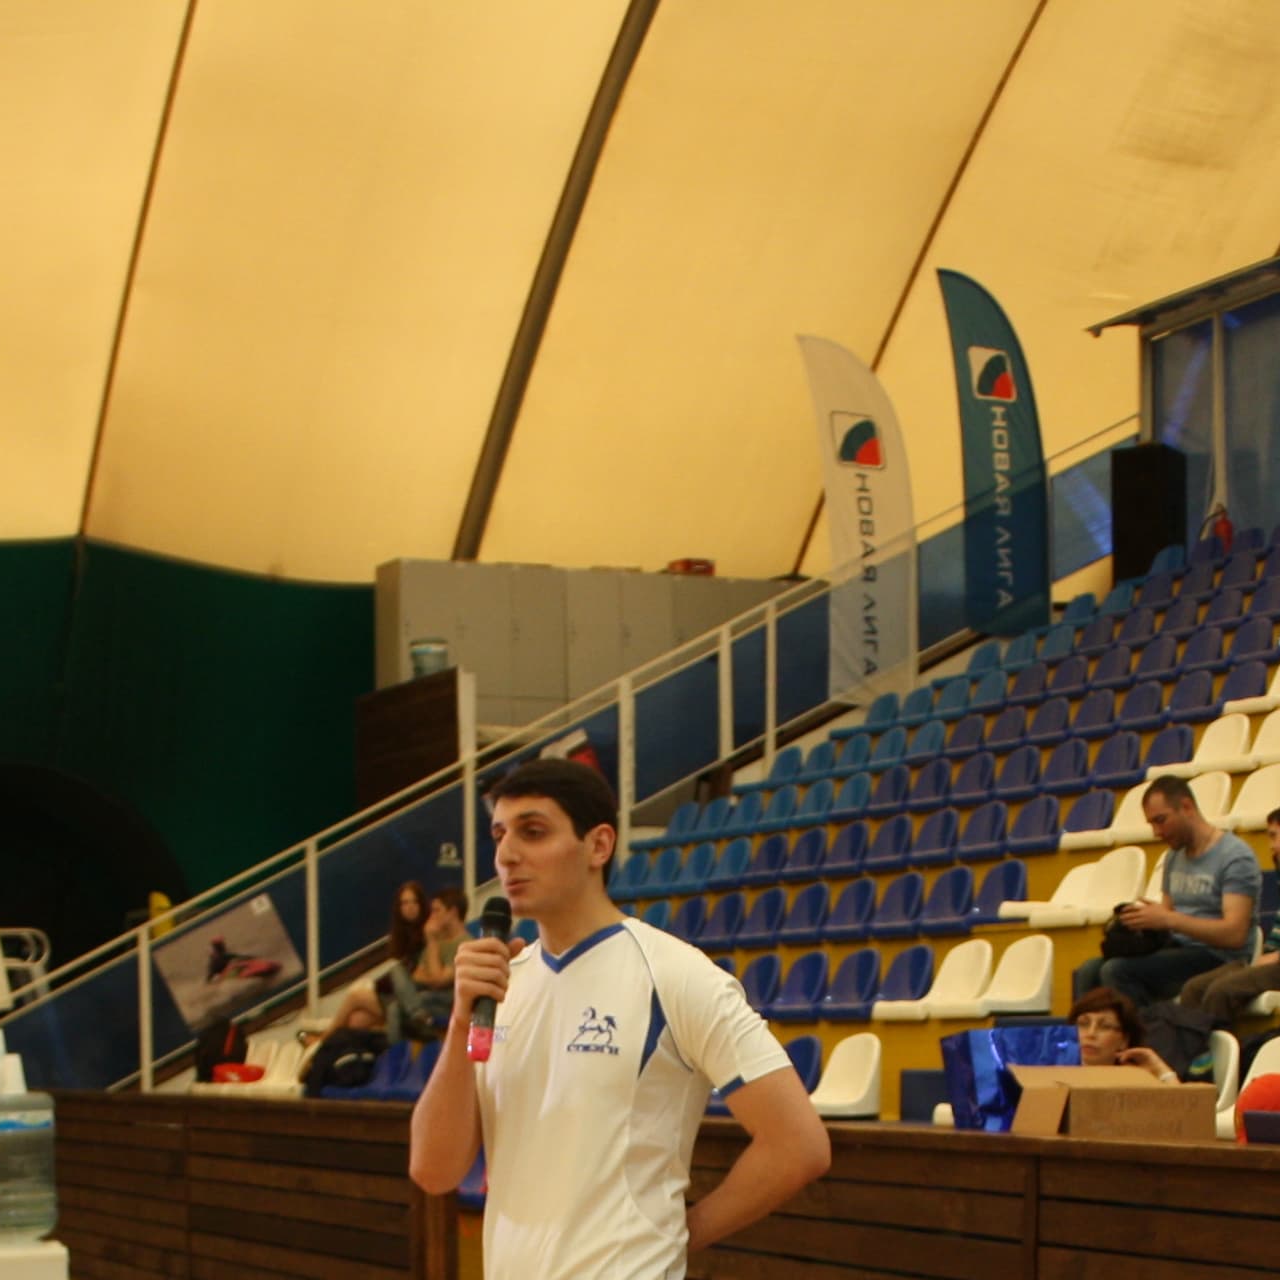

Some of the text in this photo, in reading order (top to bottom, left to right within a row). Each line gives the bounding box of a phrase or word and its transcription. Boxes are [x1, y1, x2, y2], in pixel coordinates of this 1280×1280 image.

[854, 472, 879, 677] НОВАЯ ЛИГА
[990, 405, 1015, 610] НОВАЯ ЛИГА
